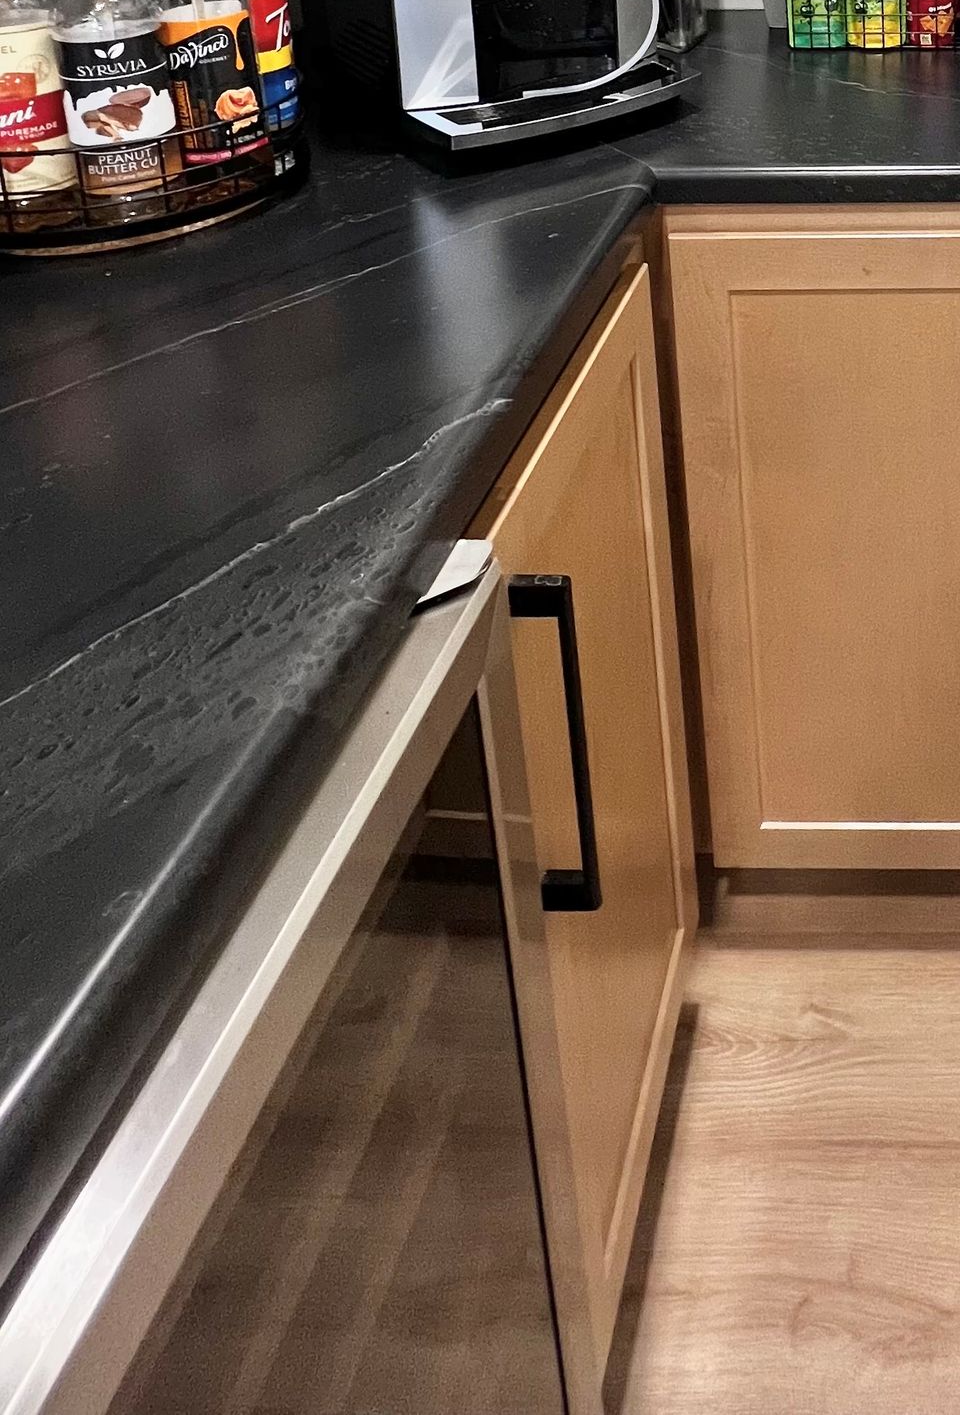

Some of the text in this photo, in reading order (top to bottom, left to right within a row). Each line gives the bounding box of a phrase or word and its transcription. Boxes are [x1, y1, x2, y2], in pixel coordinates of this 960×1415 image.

[170, 32, 229, 71] DaVinci
[76, 58, 147, 78] SYRUVIA
[88, 156, 158, 176] BUTTER CU
[98, 148, 152, 166] PEANUT
